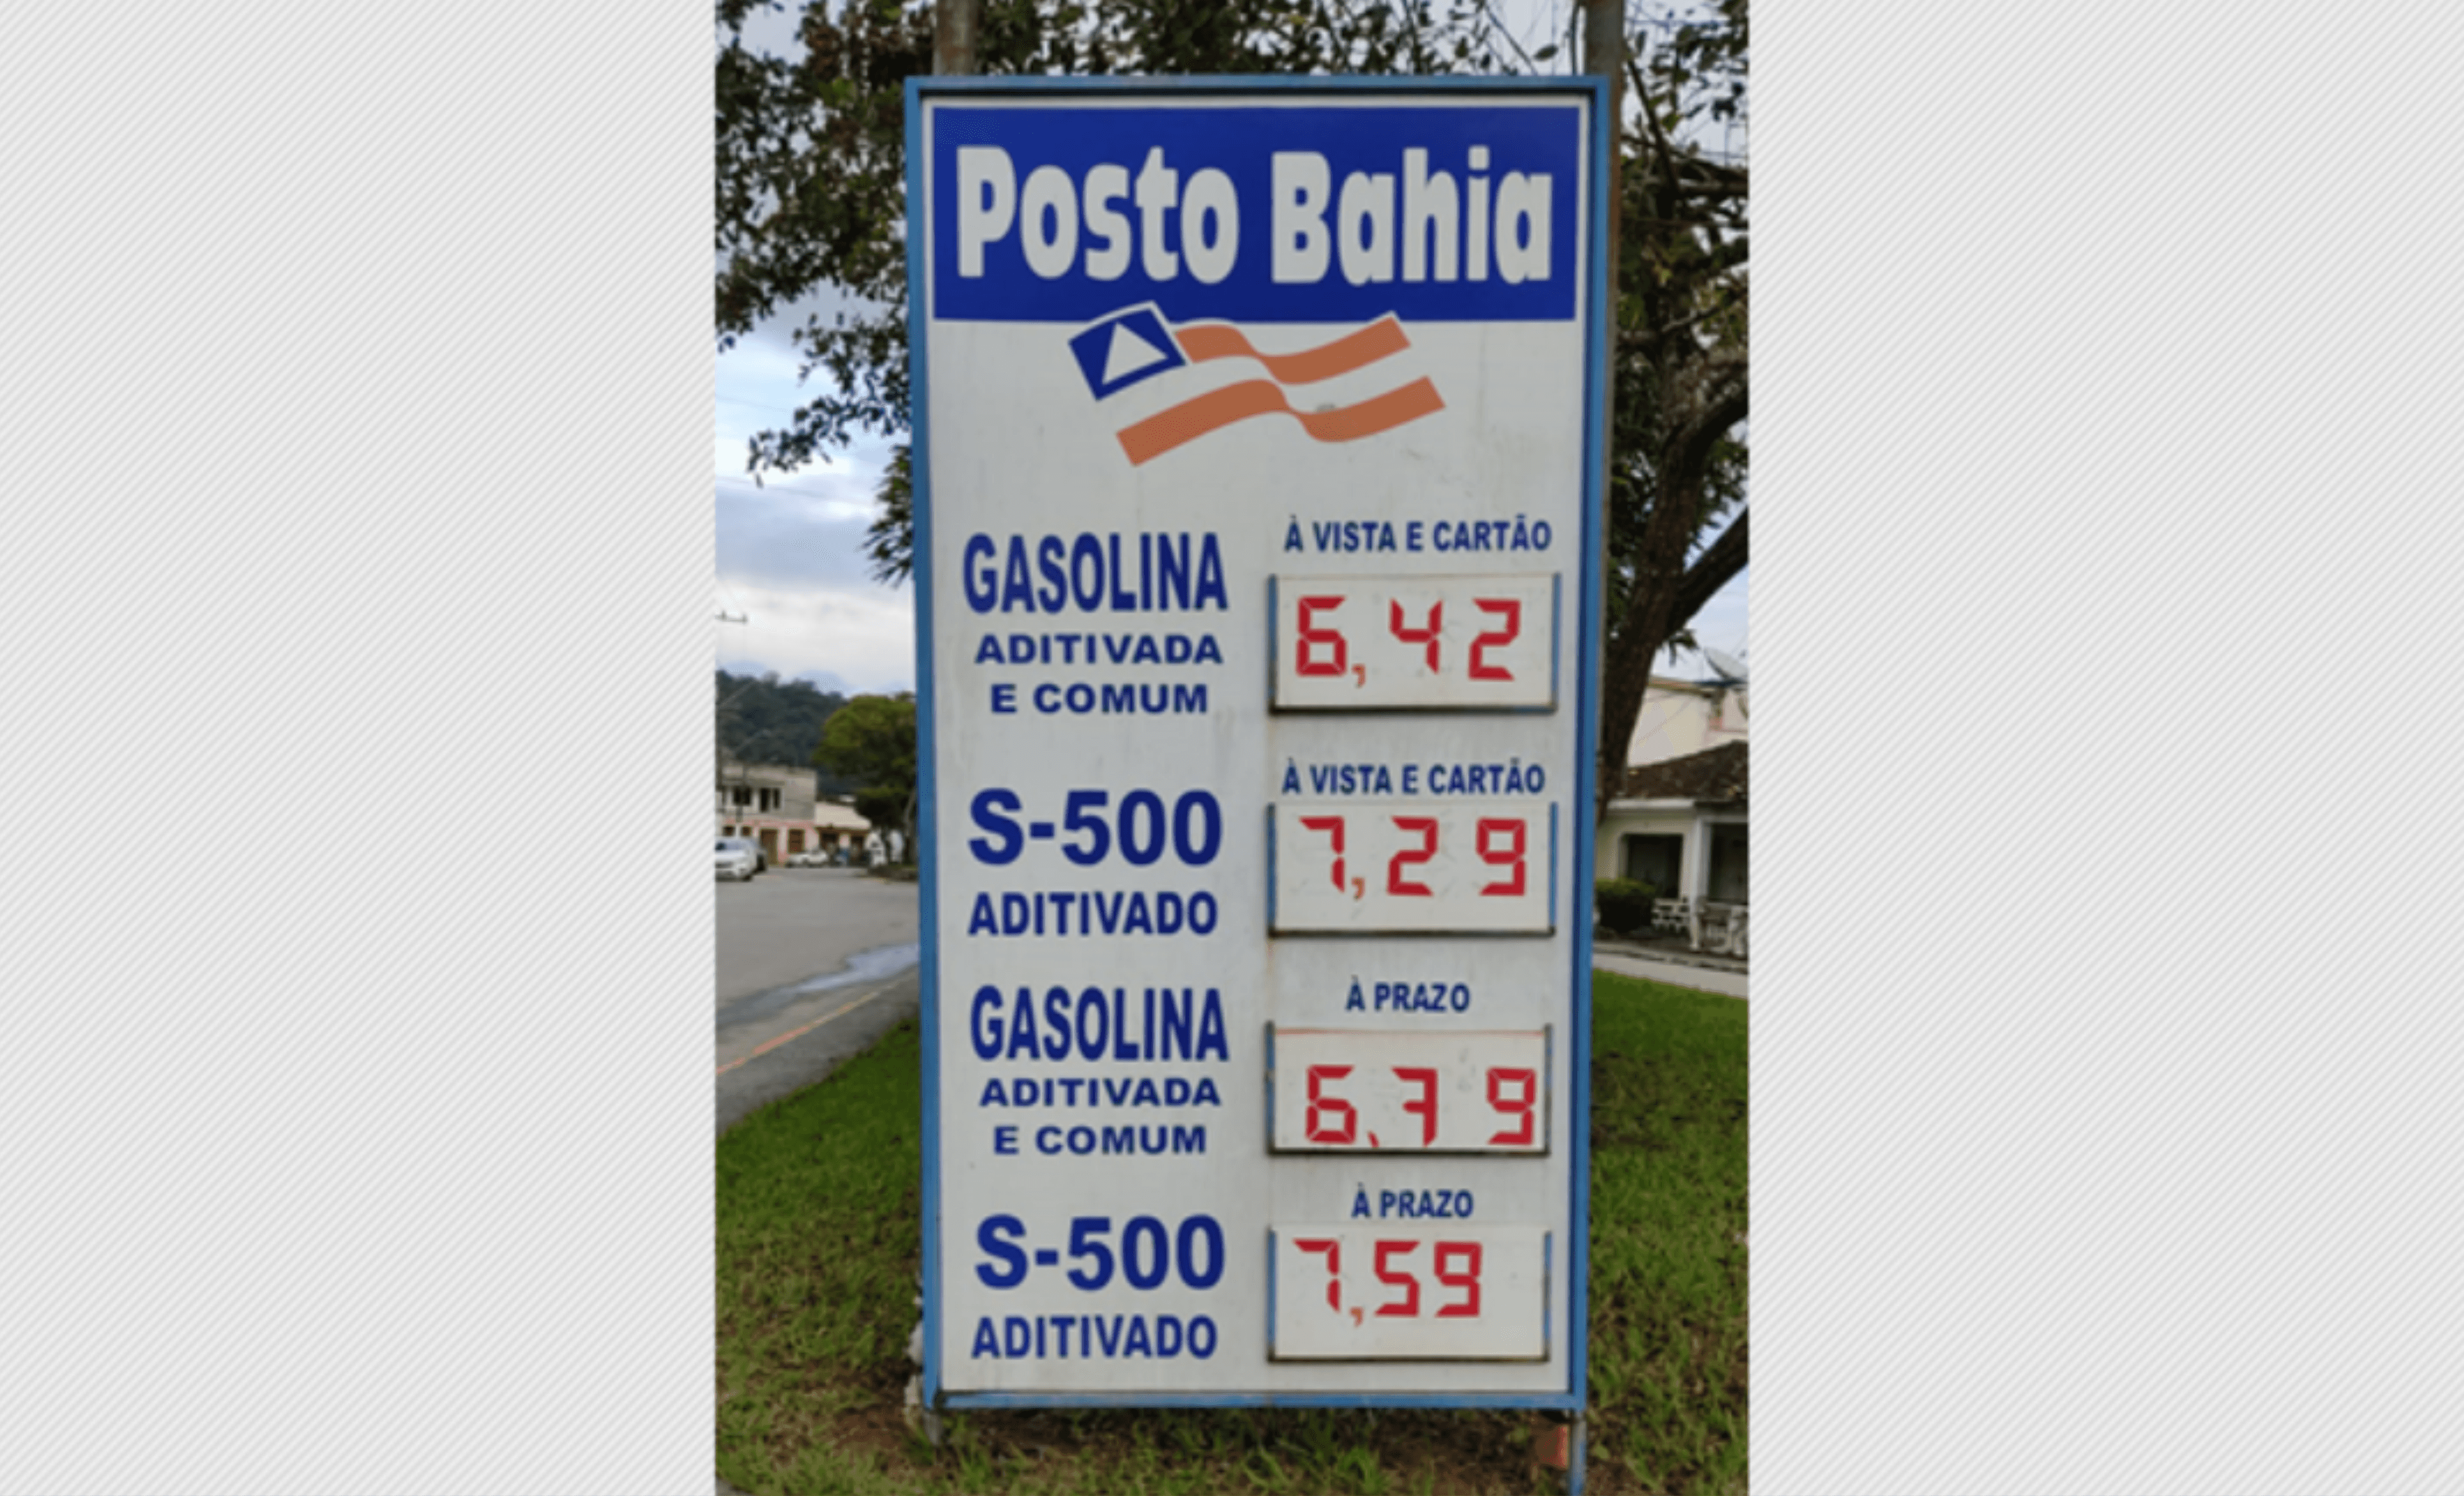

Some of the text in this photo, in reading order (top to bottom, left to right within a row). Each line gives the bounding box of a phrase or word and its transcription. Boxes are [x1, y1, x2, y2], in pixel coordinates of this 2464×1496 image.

[957, 146, 1552, 284] Posto Bahia
[1284, 514, 1552, 553] À VISTA E CARTÃO
[963, 532, 1228, 614] GASOLINA
[975, 633, 1222, 664] ADITIVADA
[1295, 594, 1521, 686] 6,42
[991, 683, 1208, 714] E COMUM
[1281, 757, 1546, 795] À VISTA E CARTÃO
[968, 788, 1222, 866] S-500
[1299, 814, 1527, 900] 7,29
[968, 890, 1218, 936] ADITIVADO
[1346, 976, 1470, 1013] À PRAZO
[970, 984, 1229, 1062] GASOLINA
[980, 1077, 1221, 1107] ADITIVADA
[1305, 1063, 1537, 1149] 6,79
[993, 1125, 1206, 1156] E COMUM
[1351, 1182, 1474, 1219] À PRAZO
[975, 1214, 1226, 1291] S-500
[1294, 1237, 1484, 1326] 7,59
[971, 1314, 1218, 1360] ADITIVADO
